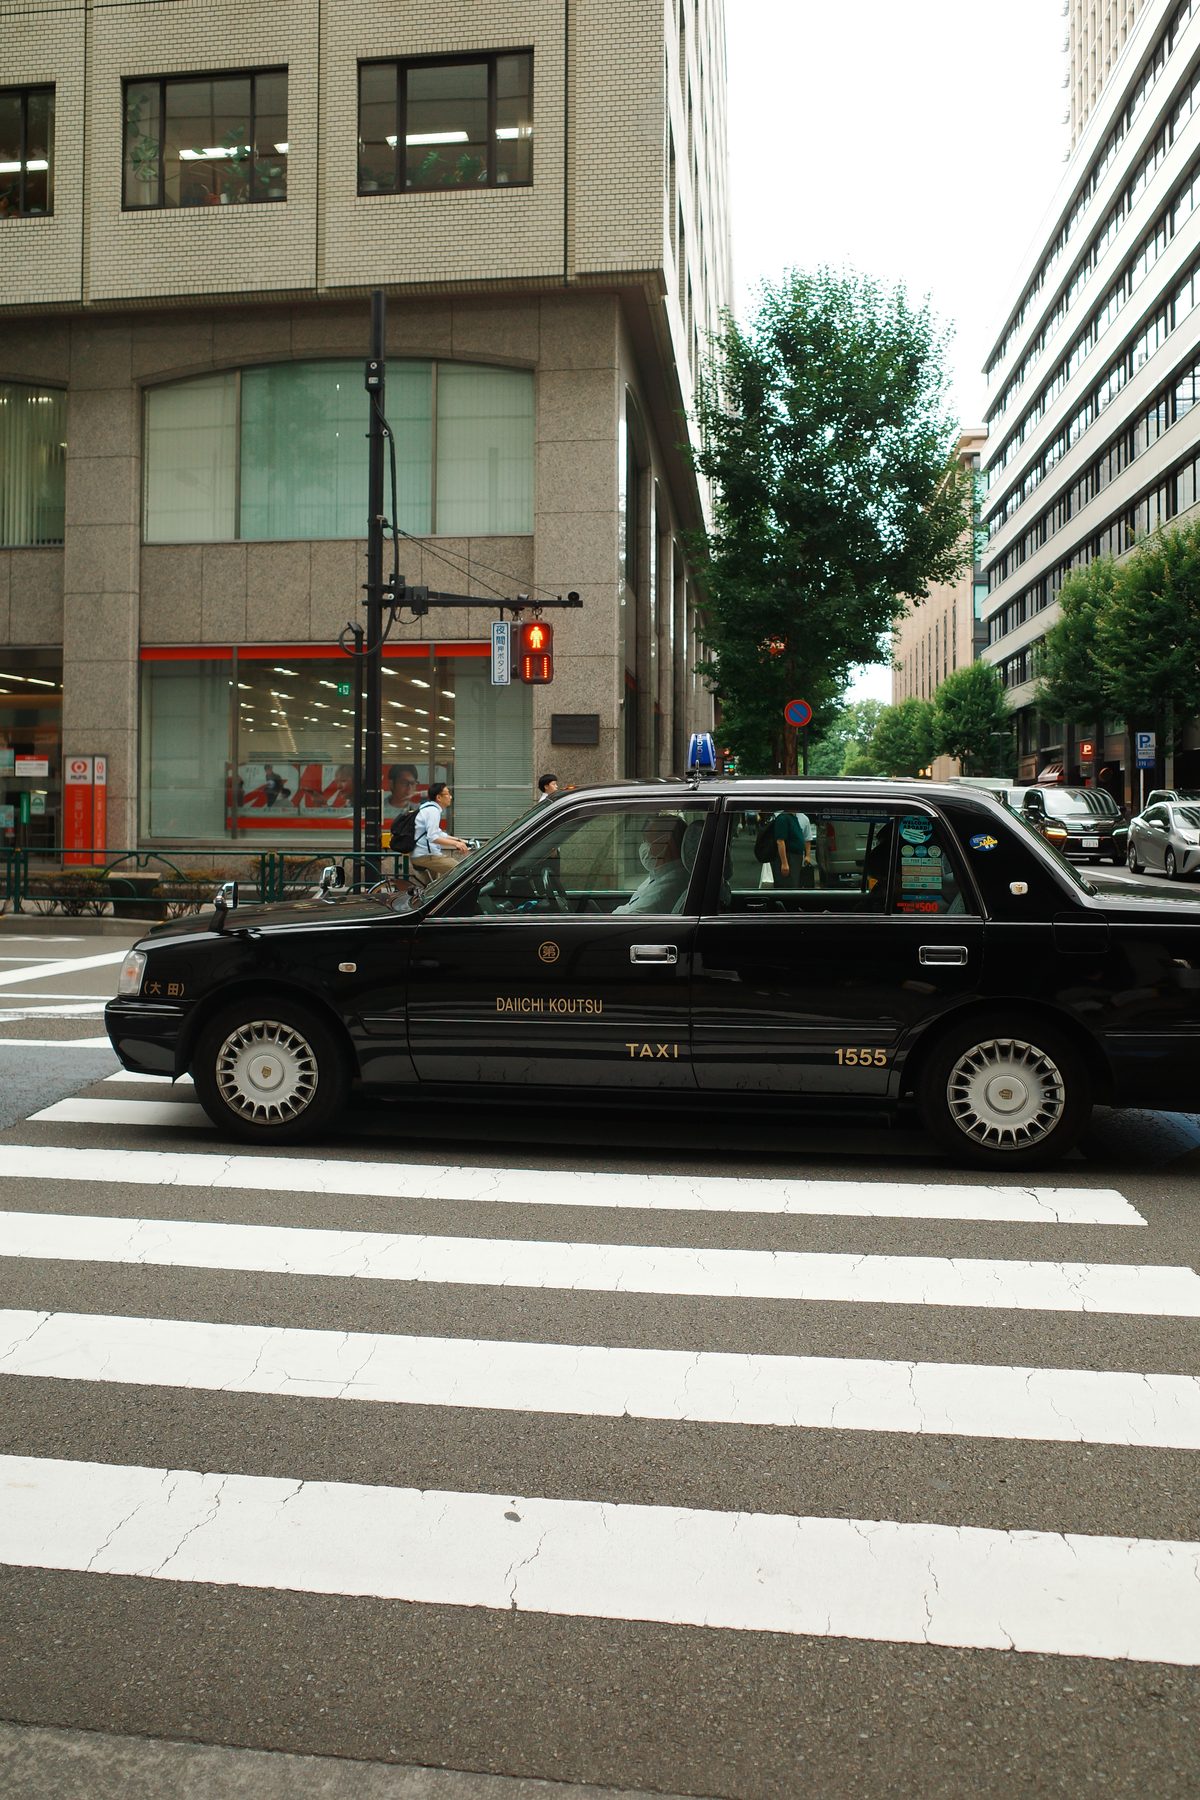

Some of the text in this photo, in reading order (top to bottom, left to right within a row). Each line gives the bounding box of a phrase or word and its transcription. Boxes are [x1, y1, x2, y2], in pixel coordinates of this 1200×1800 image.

[1083, 744, 1092, 752] P
[1139, 735, 1151, 748] P
[496, 997, 603, 1014] DAIICHI KOUTSU
[625, 1043, 678, 1058] TAXI
[834, 1048, 887, 1066] 1555
